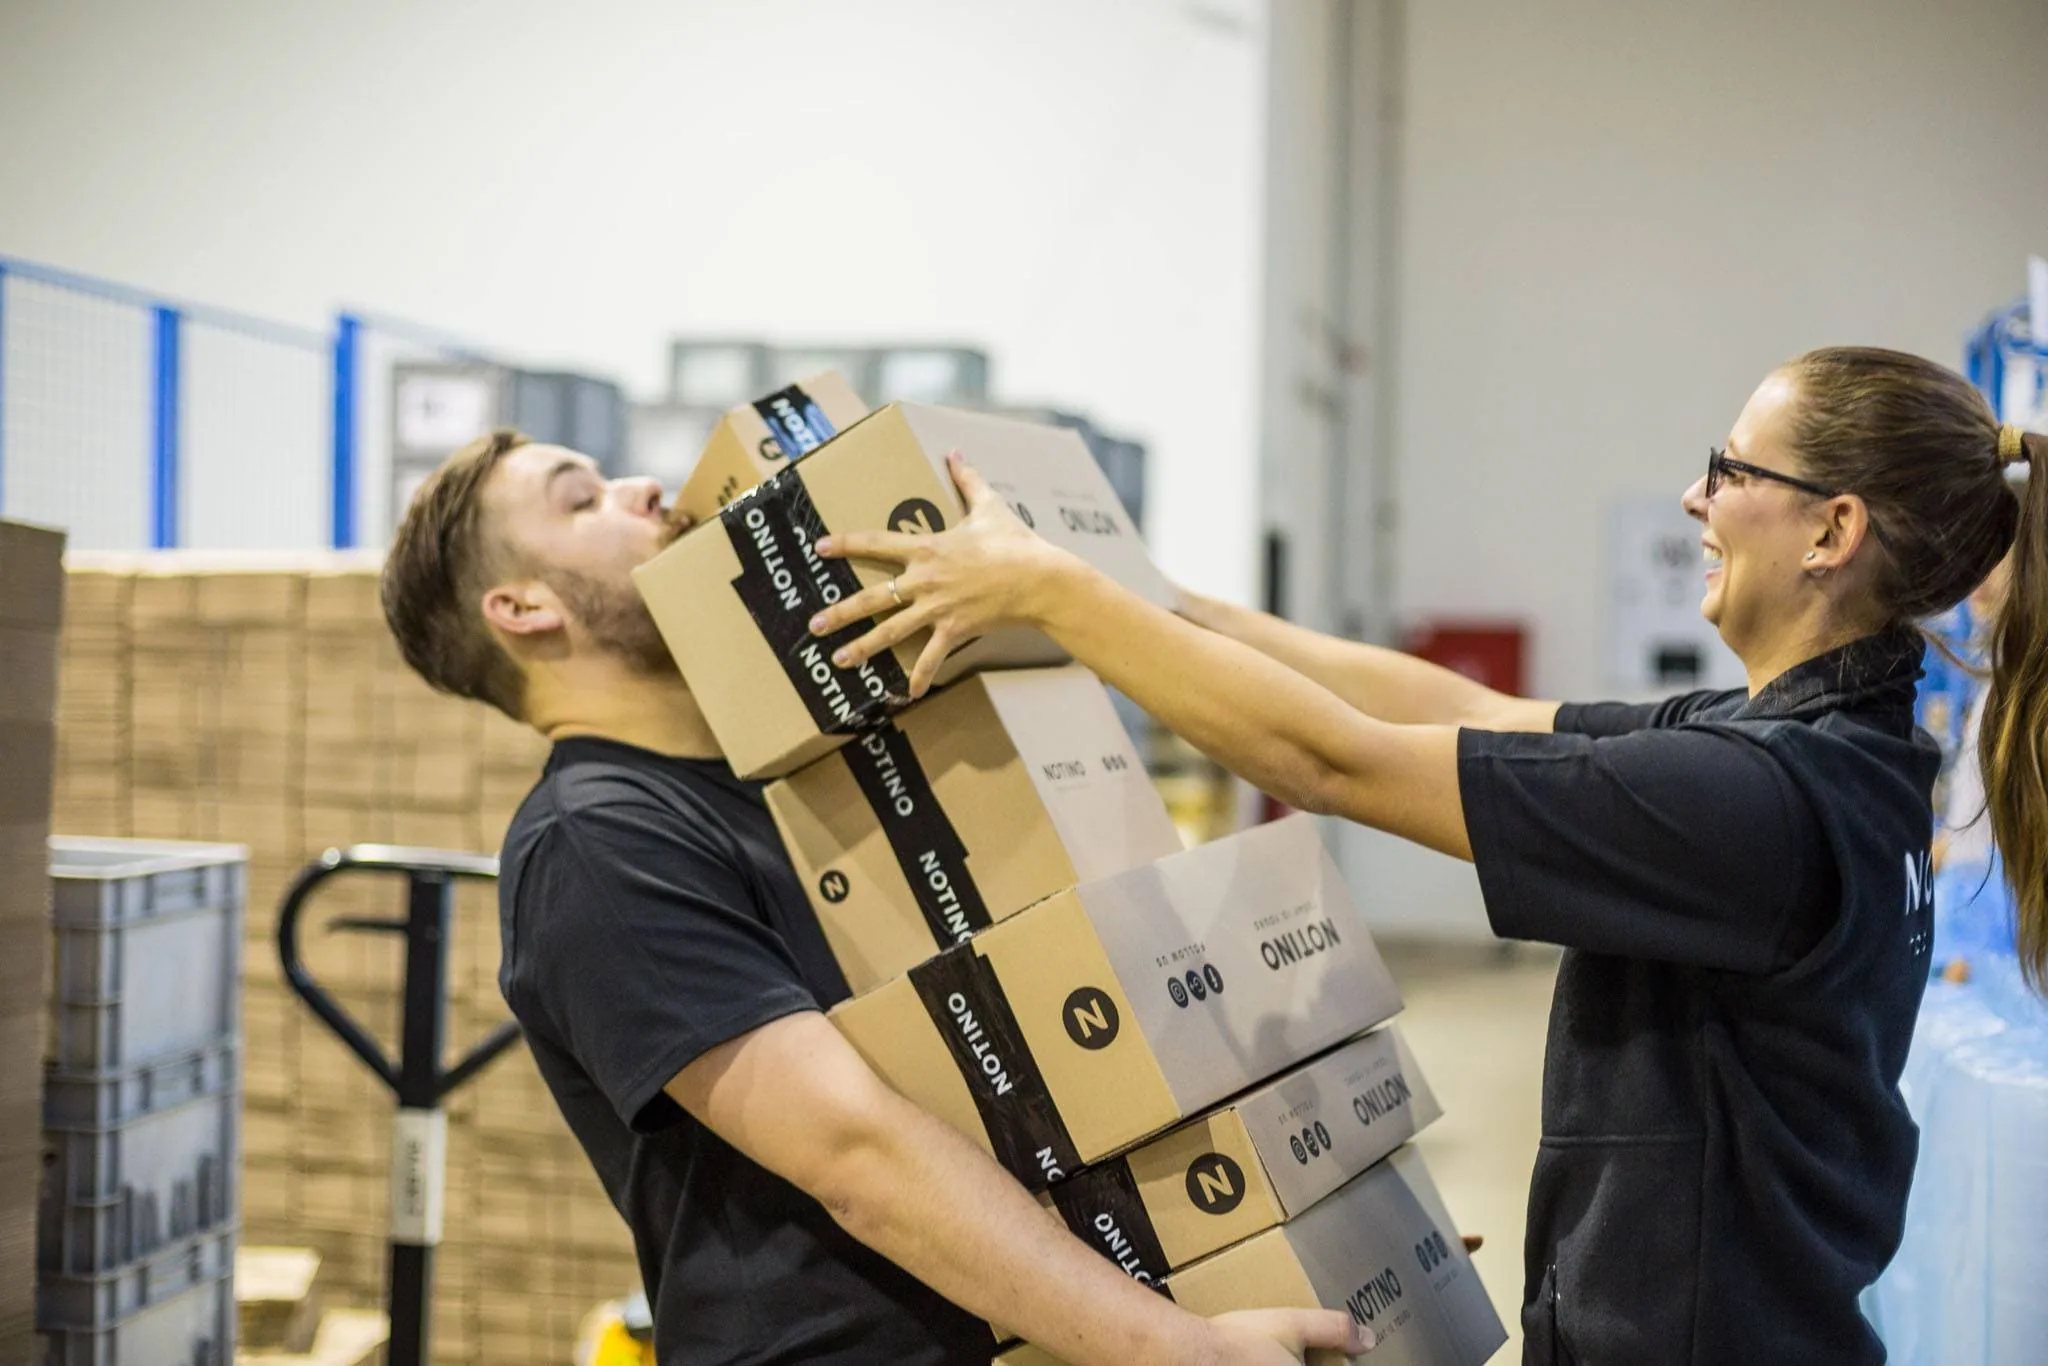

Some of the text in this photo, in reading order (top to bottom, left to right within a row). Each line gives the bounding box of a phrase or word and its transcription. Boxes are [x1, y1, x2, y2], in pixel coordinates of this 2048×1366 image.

[746, 507, 802, 611] NOTINO
[800, 643, 864, 726] NOTIN
[1156, 941, 1206, 968] FOLLOW US
[1261, 917, 1341, 971] NOTINO
[948, 992, 1013, 1096] NOTINO
[1352, 1073, 1412, 1126] NOTINO
[1345, 1266, 1402, 1326] NOTINO
